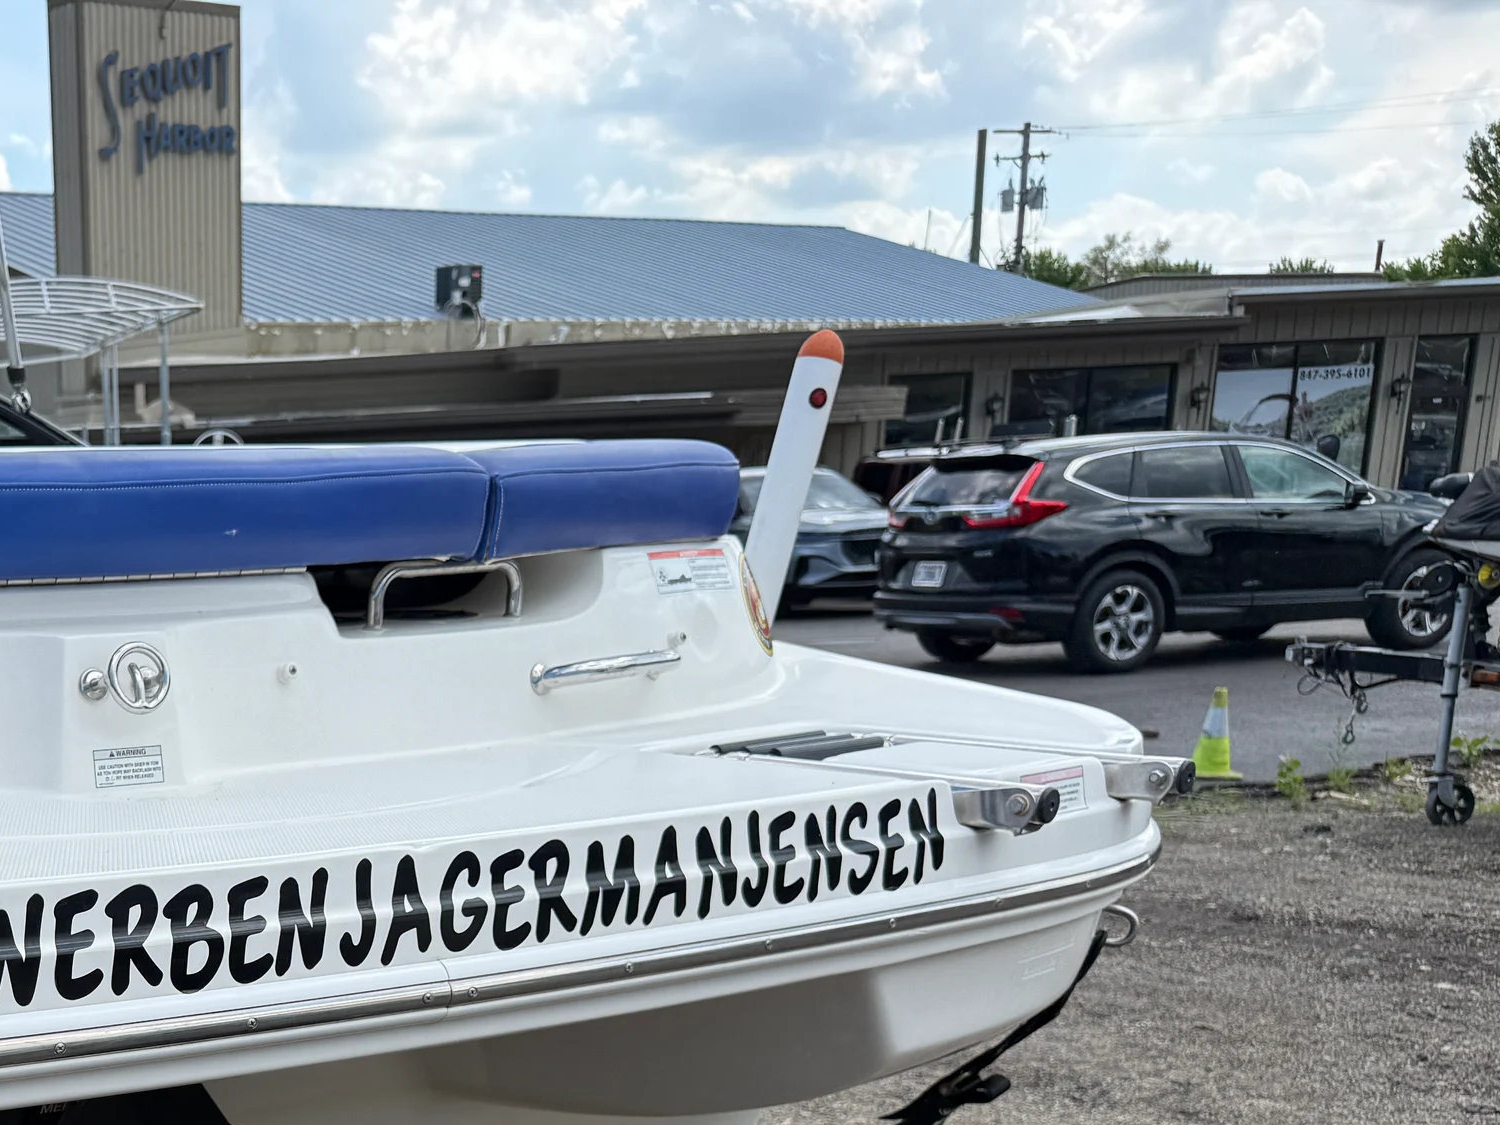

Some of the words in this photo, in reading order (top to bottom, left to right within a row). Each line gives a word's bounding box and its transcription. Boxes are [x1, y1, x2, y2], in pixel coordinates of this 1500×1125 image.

[97, 43, 232, 161] SEQUOIT
[135, 112, 236, 175] HARBOR
[116, 748, 147, 757] WARNING
